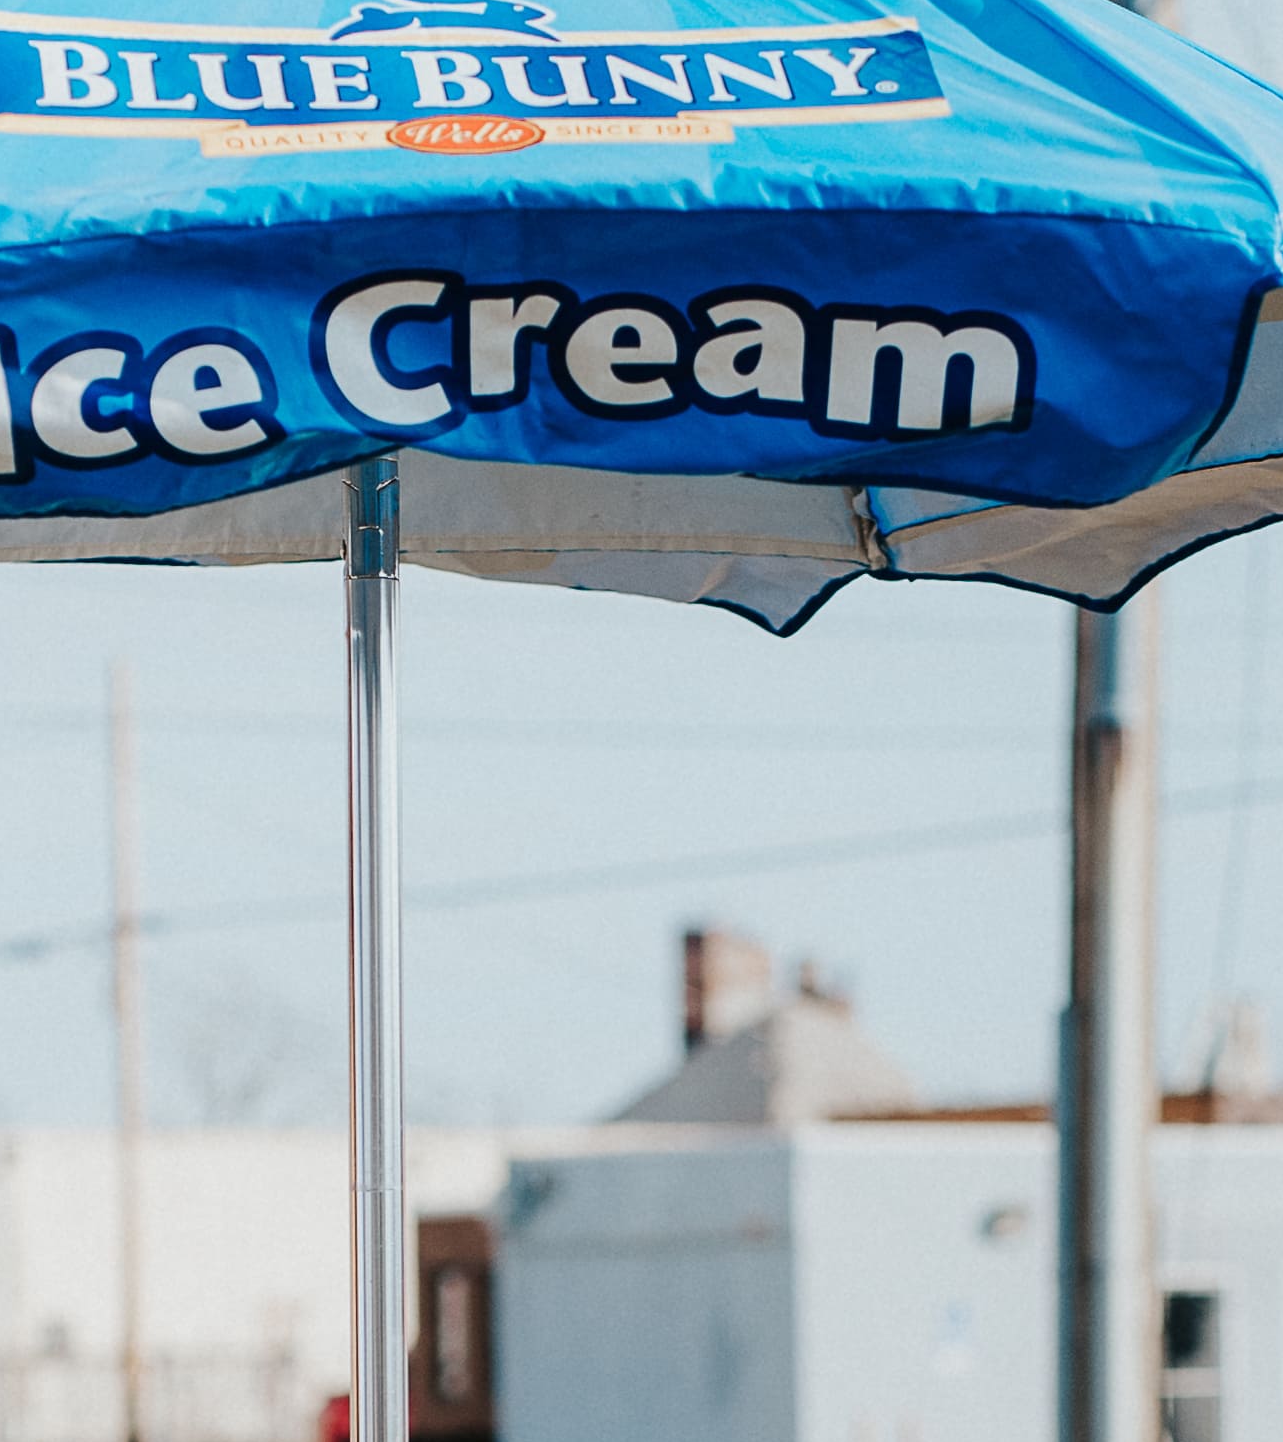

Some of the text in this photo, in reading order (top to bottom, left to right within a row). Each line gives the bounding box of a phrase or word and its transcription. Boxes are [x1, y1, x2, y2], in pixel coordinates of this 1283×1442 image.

[28, 39, 379, 111] BLUE
[224, 117, 713, 151] QUALITY Wells SINCE 1913
[319, 272, 1024, 436] Cream
